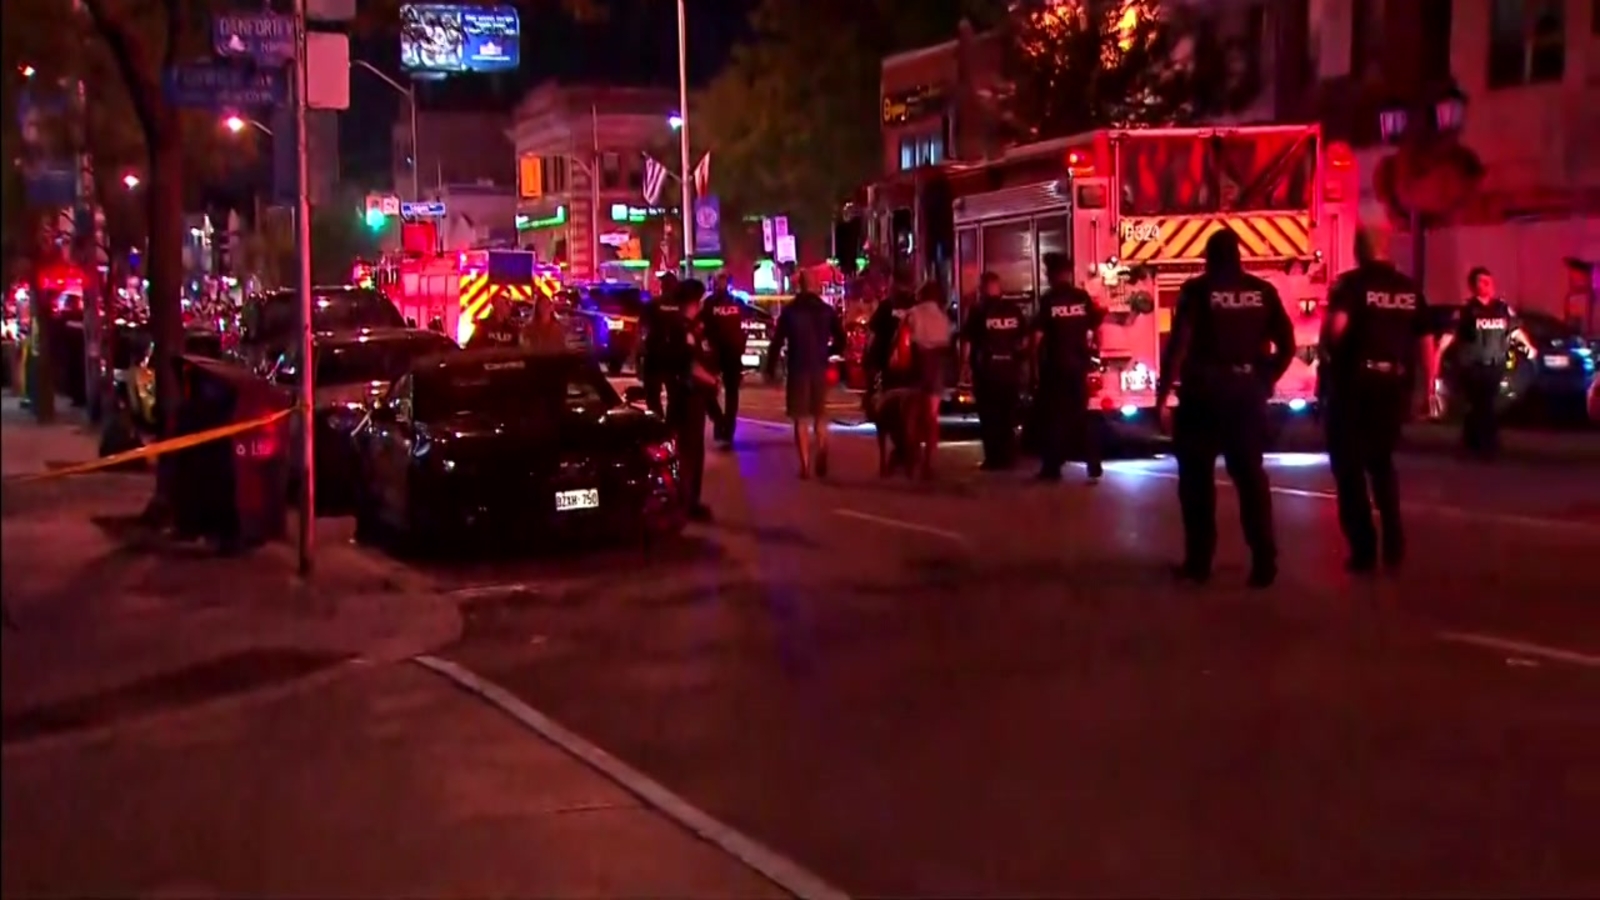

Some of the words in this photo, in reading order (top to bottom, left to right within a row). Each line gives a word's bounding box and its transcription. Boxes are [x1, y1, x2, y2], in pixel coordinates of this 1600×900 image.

[1211, 291, 1263, 309] POLICE
[1366, 291, 1416, 309] POLICE
[1051, 303, 1087, 318] POLICE
[986, 317, 1019, 330] POLICE
[1476, 317, 1507, 330] POLICE
